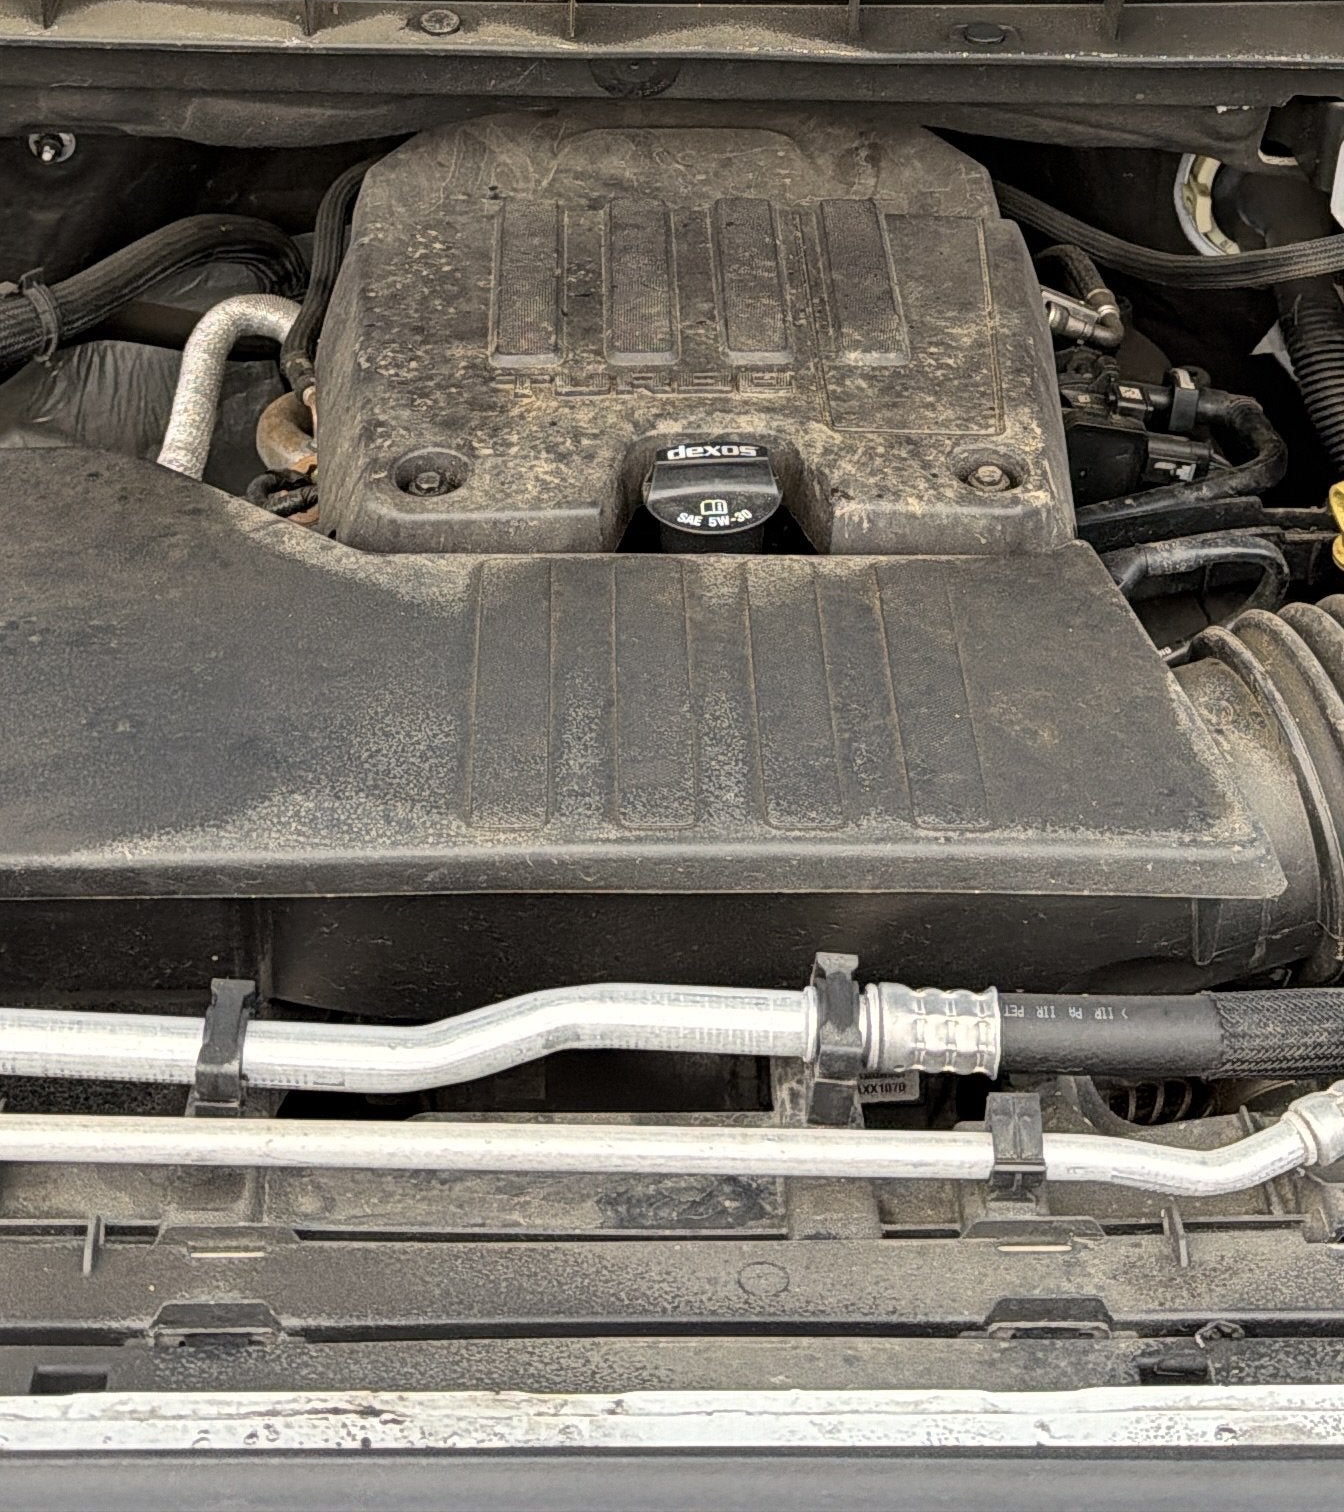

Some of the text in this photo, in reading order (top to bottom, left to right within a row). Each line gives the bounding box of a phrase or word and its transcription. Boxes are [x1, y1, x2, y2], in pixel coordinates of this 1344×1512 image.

[666, 444, 760, 461] dexos
[677, 508, 753, 528] SAE 5W-30
[1003, 1004, 1025, 1018] PET
